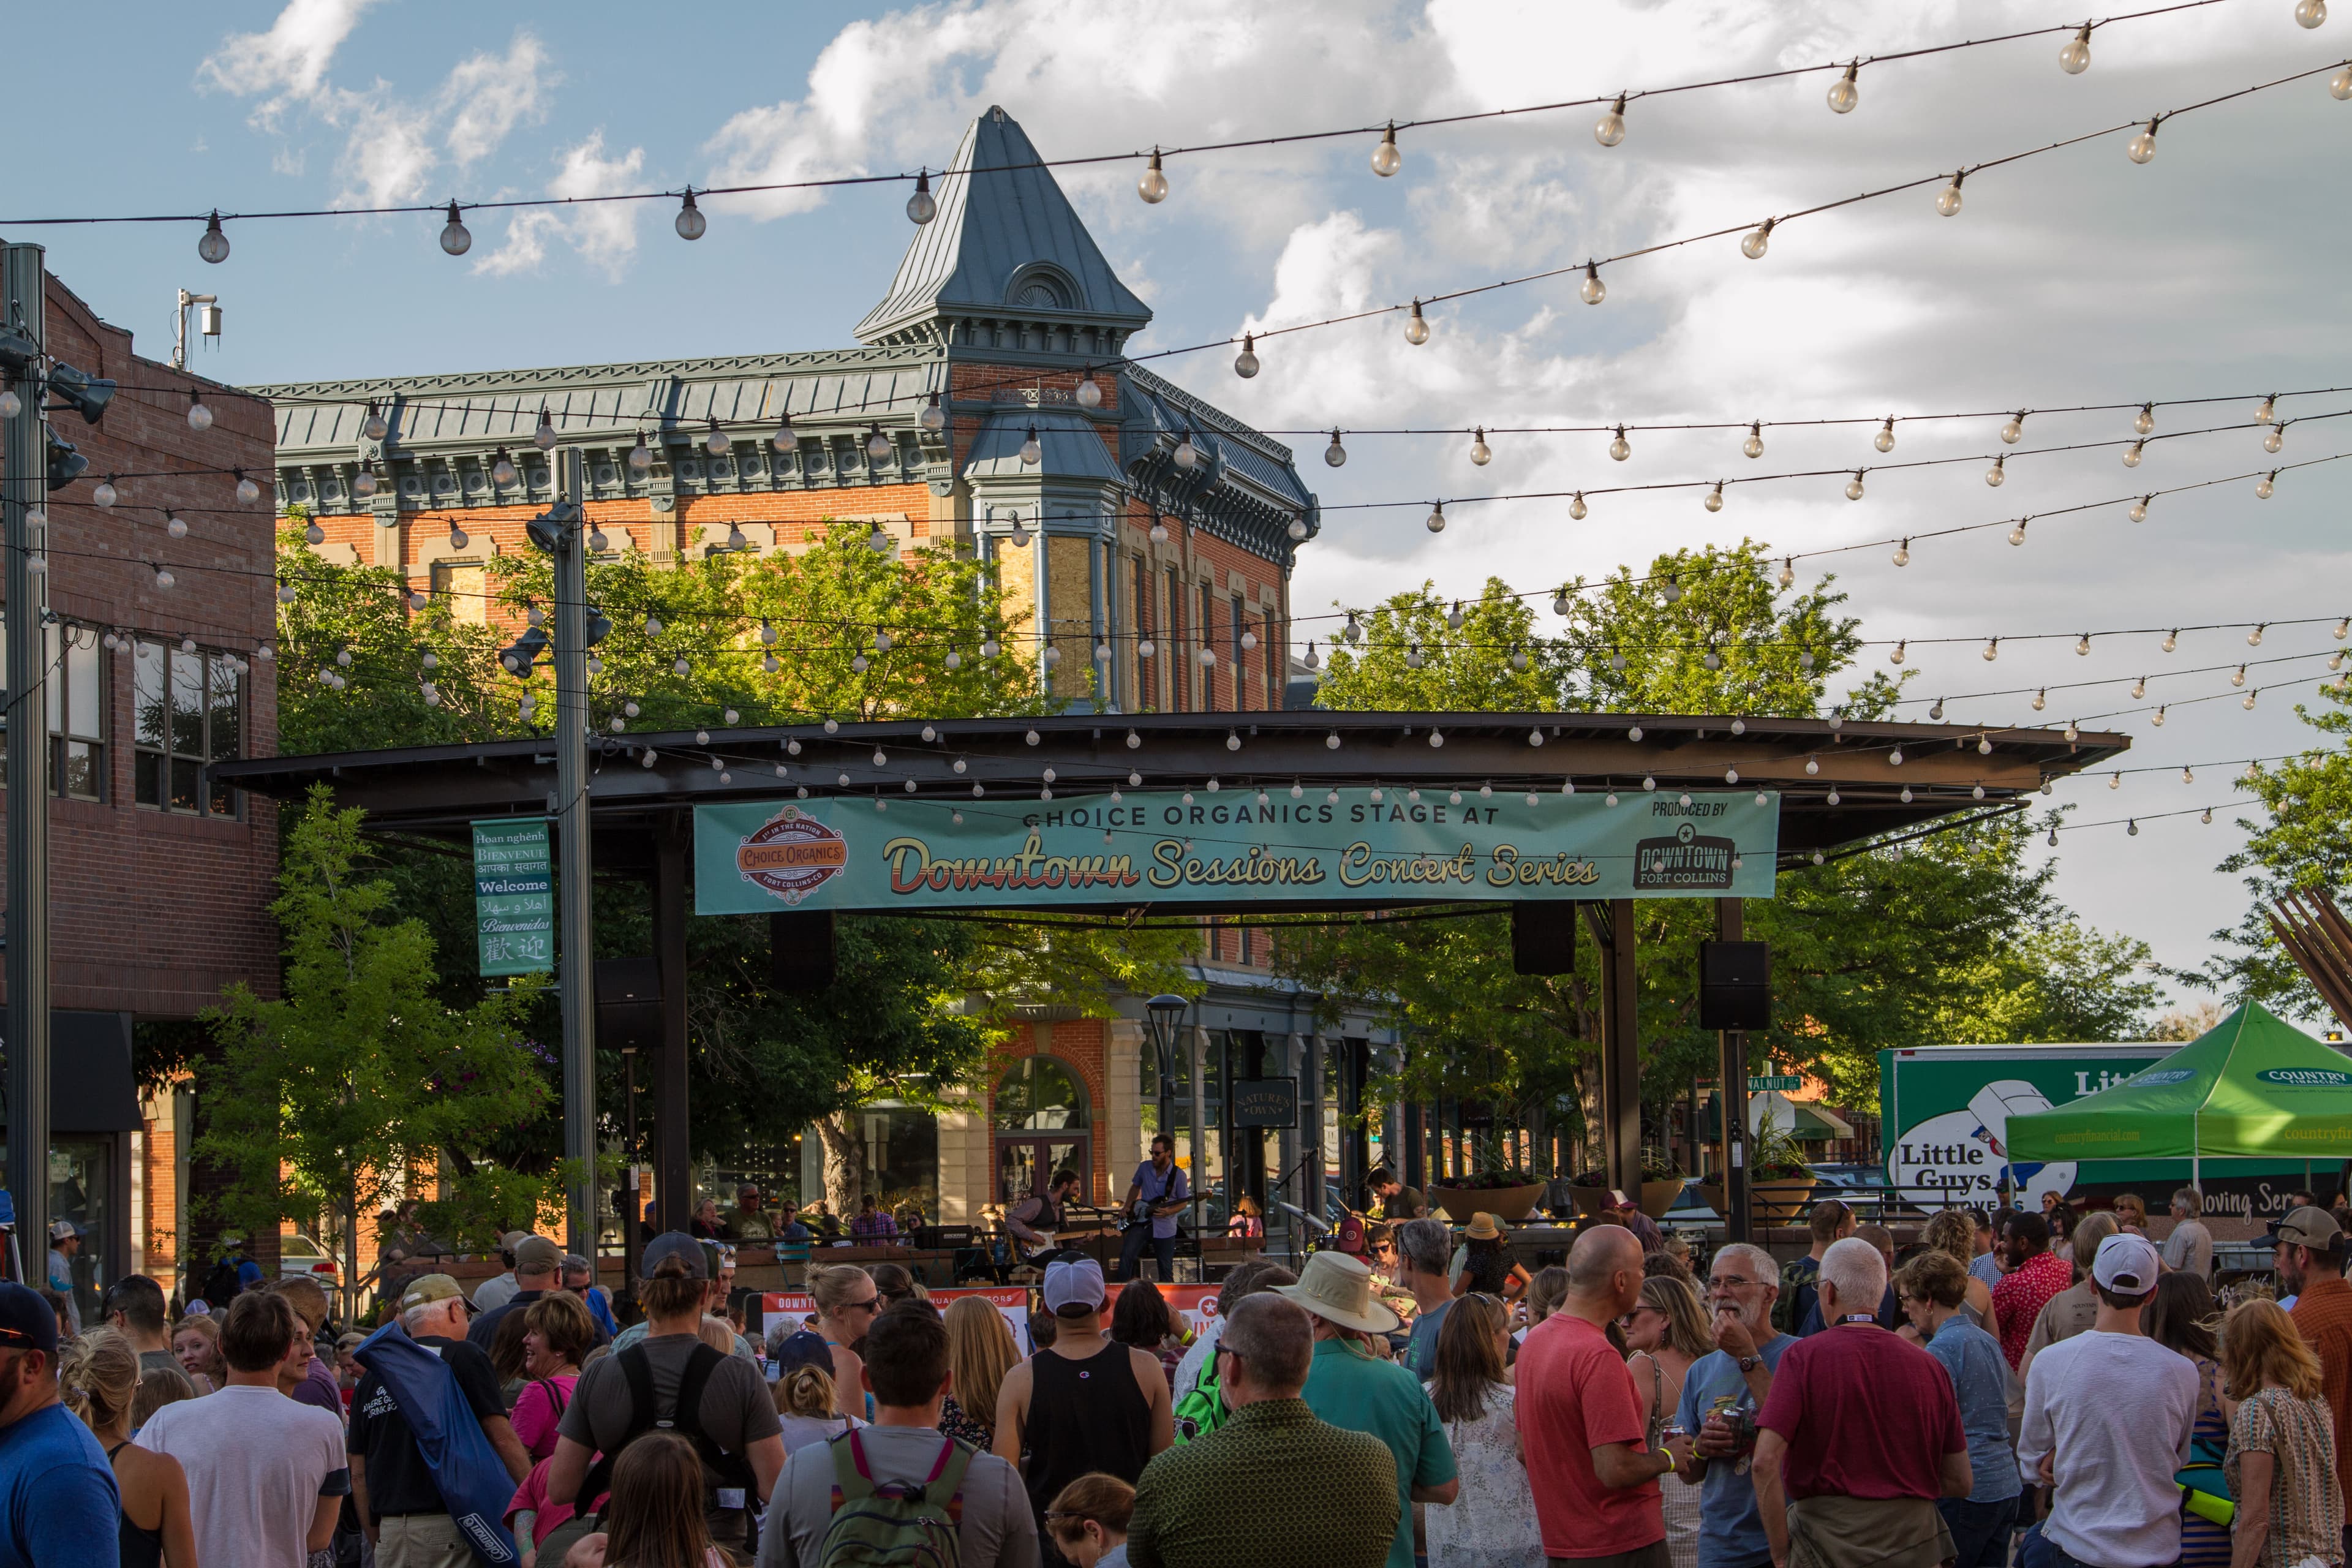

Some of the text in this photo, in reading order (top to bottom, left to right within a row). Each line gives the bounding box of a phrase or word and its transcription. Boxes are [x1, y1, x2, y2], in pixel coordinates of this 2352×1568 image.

[1023, 804, 1499, 828] CHOICE ORGANICS STAGE AT
[1652, 802, 1728, 816] PRODUCED BY
[796, 823, 821, 835] NATION
[476, 831, 545, 844] Hoan nghênh
[744, 846, 840, 867] CHOICE ORGANICS
[1640, 845, 1728, 872] DOWNTOWN
[883, 835, 1600, 895] Downtown Sessions Concert Series
[763, 876, 781, 886] FORT
[1640, 873, 1727, 883] FORT COLLINS
[479, 880, 548, 893] Welcome
[480, 918, 549, 933] Bienvenidos
[484, 935, 548, 964] 歡迎
[1747, 1077, 1785, 1090] WALNUT
[2269, 1071, 2347, 1081] COUNTRY
[1236, 1092, 1289, 1108] NATURE'S
[1250, 1106, 1276, 1115] OWN
[2055, 1128, 2140, 1145] countryfinancial.com
[1901, 1143, 1984, 1164] Little
[1915, 1169, 1991, 1196] Guys
[2259, 1183, 2293, 1212] Ser
[470, 1525, 505, 1560] Coleman
